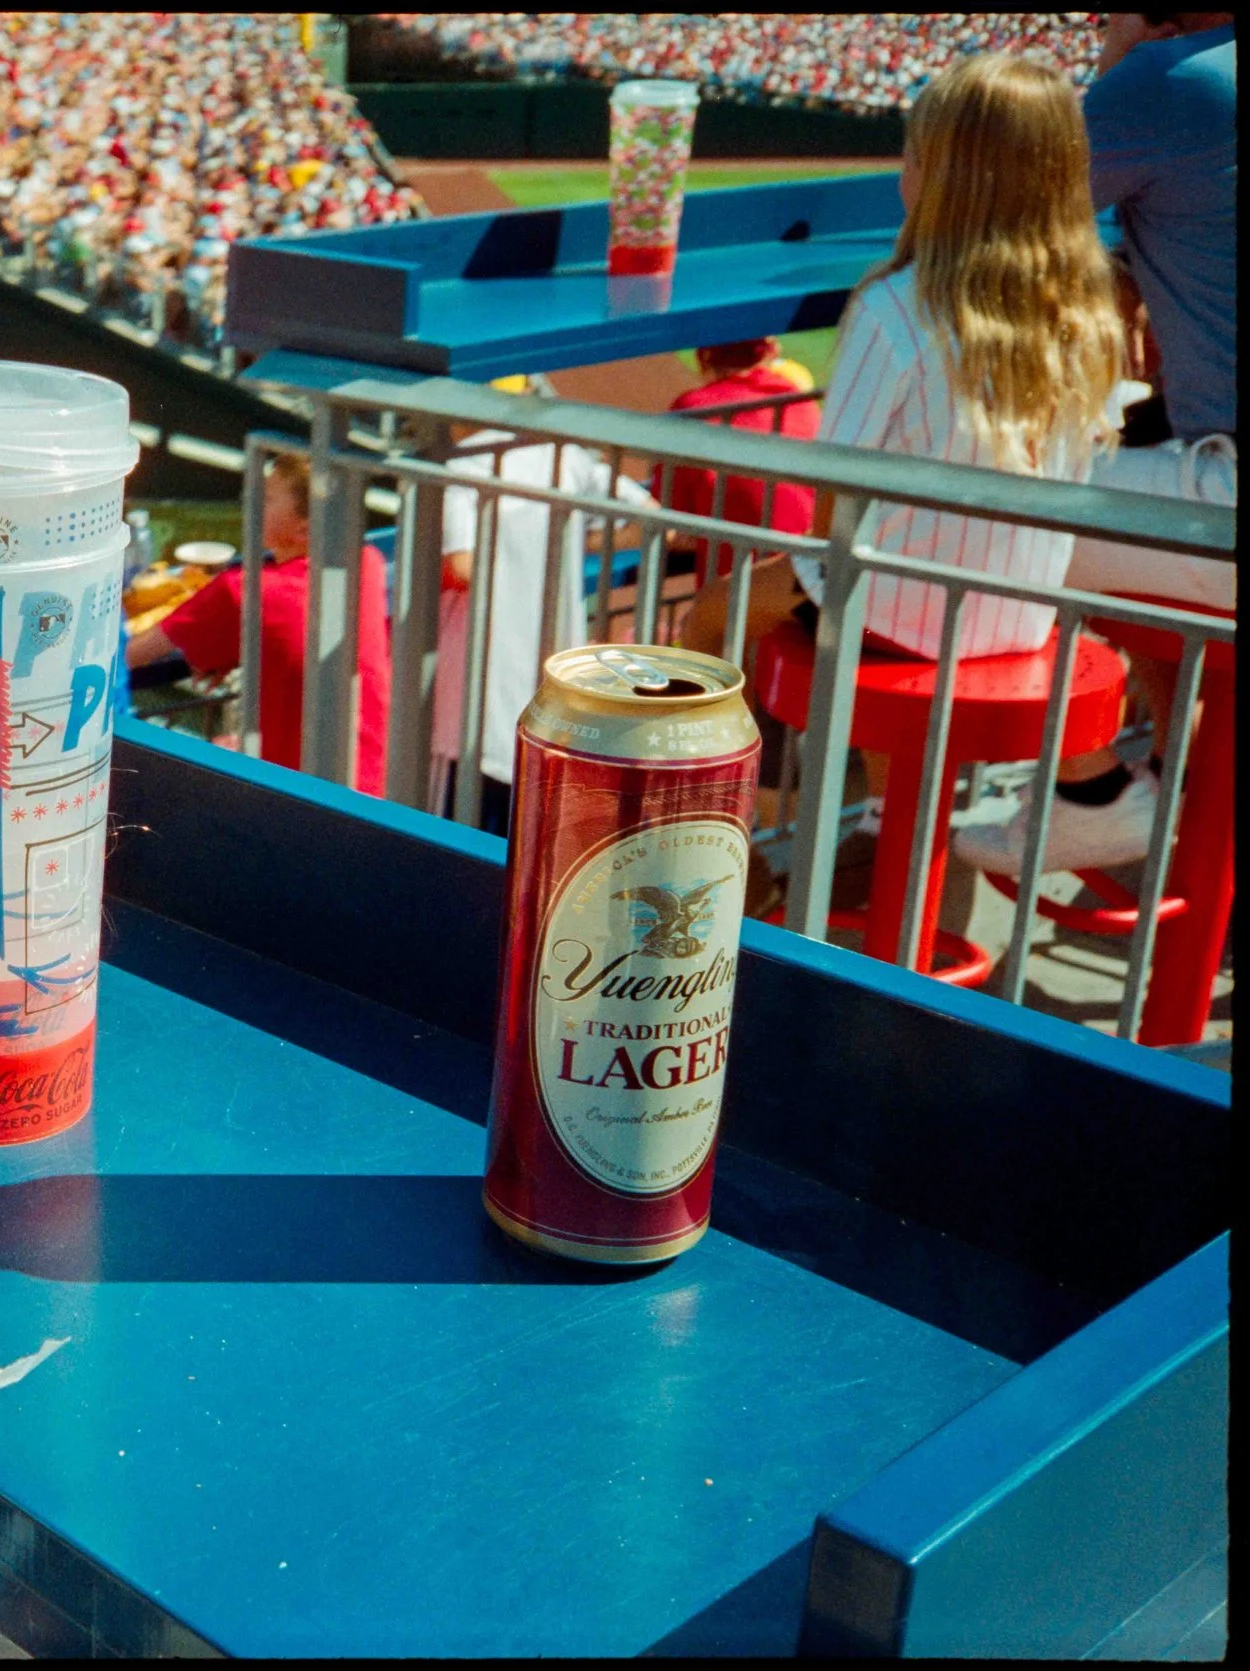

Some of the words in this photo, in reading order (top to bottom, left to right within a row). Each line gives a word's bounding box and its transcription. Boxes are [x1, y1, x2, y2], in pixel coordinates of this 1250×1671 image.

[677, 720, 713, 738] PINT
[658, 835, 724, 850] OLDEST
[584, 1007, 727, 1040] TRADITIONAL
[558, 1026, 728, 1090] LAGER
[0, 1114, 41, 1131] ZERO
[46, 1094, 83, 1121] SUGAR
[585, 1106, 647, 1129] Original
